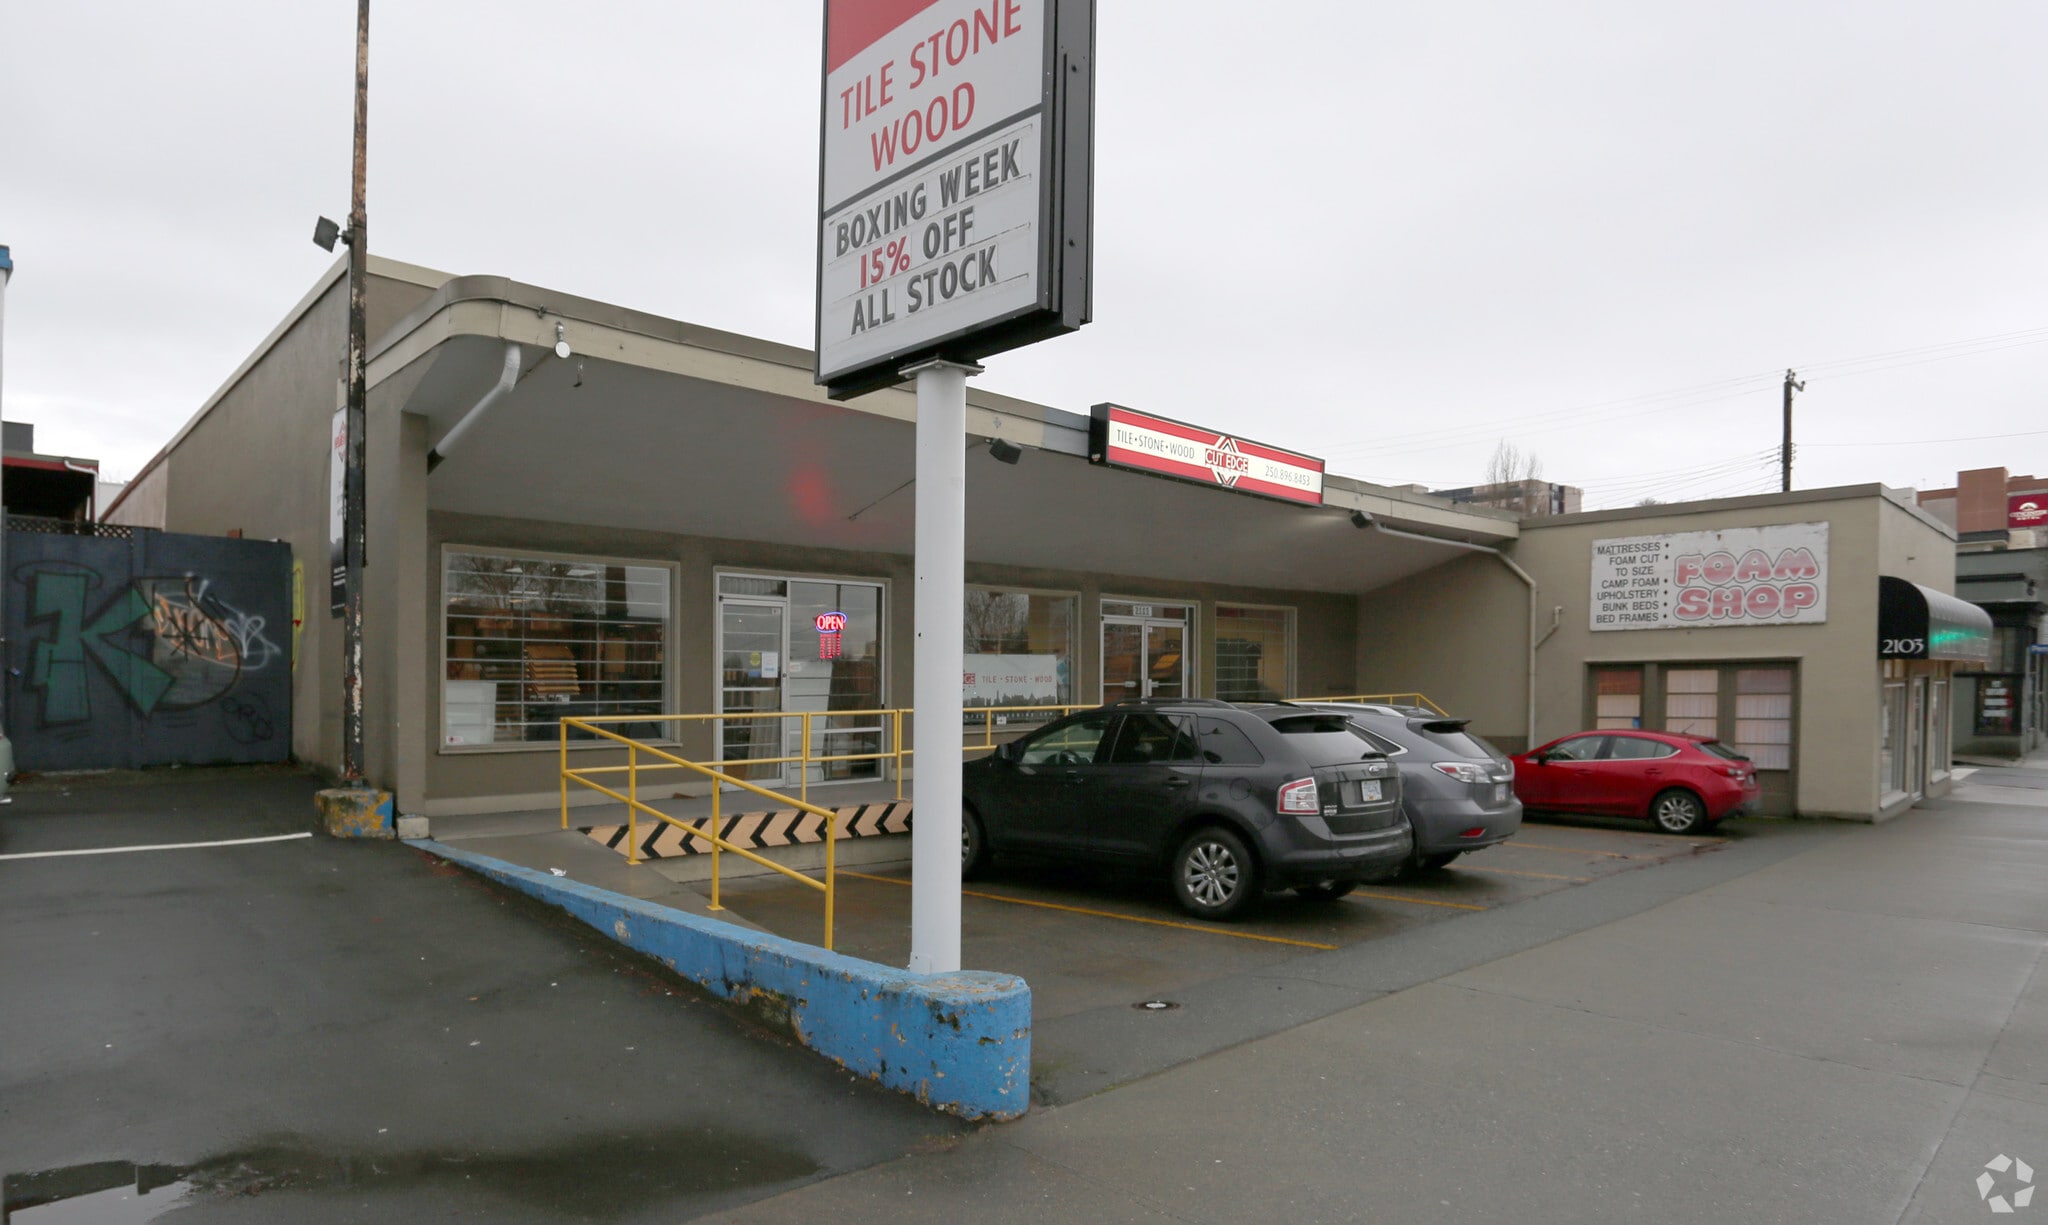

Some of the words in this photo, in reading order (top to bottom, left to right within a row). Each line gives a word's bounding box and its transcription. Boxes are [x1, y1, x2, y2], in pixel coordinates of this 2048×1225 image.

[840, 60, 895, 129] TILE
[910, 0, 1022, 90] STONE
[871, 82, 975, 172] WOOD
[836, 183, 927, 257] BOXING
[940, 138, 1021, 204] WEEK
[860, 236, 911, 289] 15%
[923, 206, 974, 259] OFF
[851, 288, 896, 335] ALL
[907, 244, 998, 313] STOCK
[1205, 448, 1224, 467] CUT
[1225, 452, 1249, 473] EDGE
[1597, 542, 1661, 555] MATTRESSES
[1609, 556, 1637, 566] FOAM
[1640, 554, 1659, 564] CUT
[1673, 547, 1819, 588] FOAM
[1616, 567, 1629, 577] TO
[1633, 566, 1654, 576] SIZE
[1602, 579, 1629, 589] CAMP
[1632, 577, 1660, 588] FOAM
[1597, 589, 1659, 601] UPHOLSTERY
[1673, 583, 1819, 620] SHOP
[1602, 602, 1628, 612] BUNK
[1632, 601, 1659, 611] BEDS
[816, 614, 845, 631] OPEN
[1596, 614, 1616, 624] BED
[1618, 612, 1659, 623] FRAMES
[1882, 637, 1924, 654] 2103
[982, 675, 997, 684] TILE
[1004, 675, 1028, 684] STONE
[1034, 675, 1053, 684] WOOD
